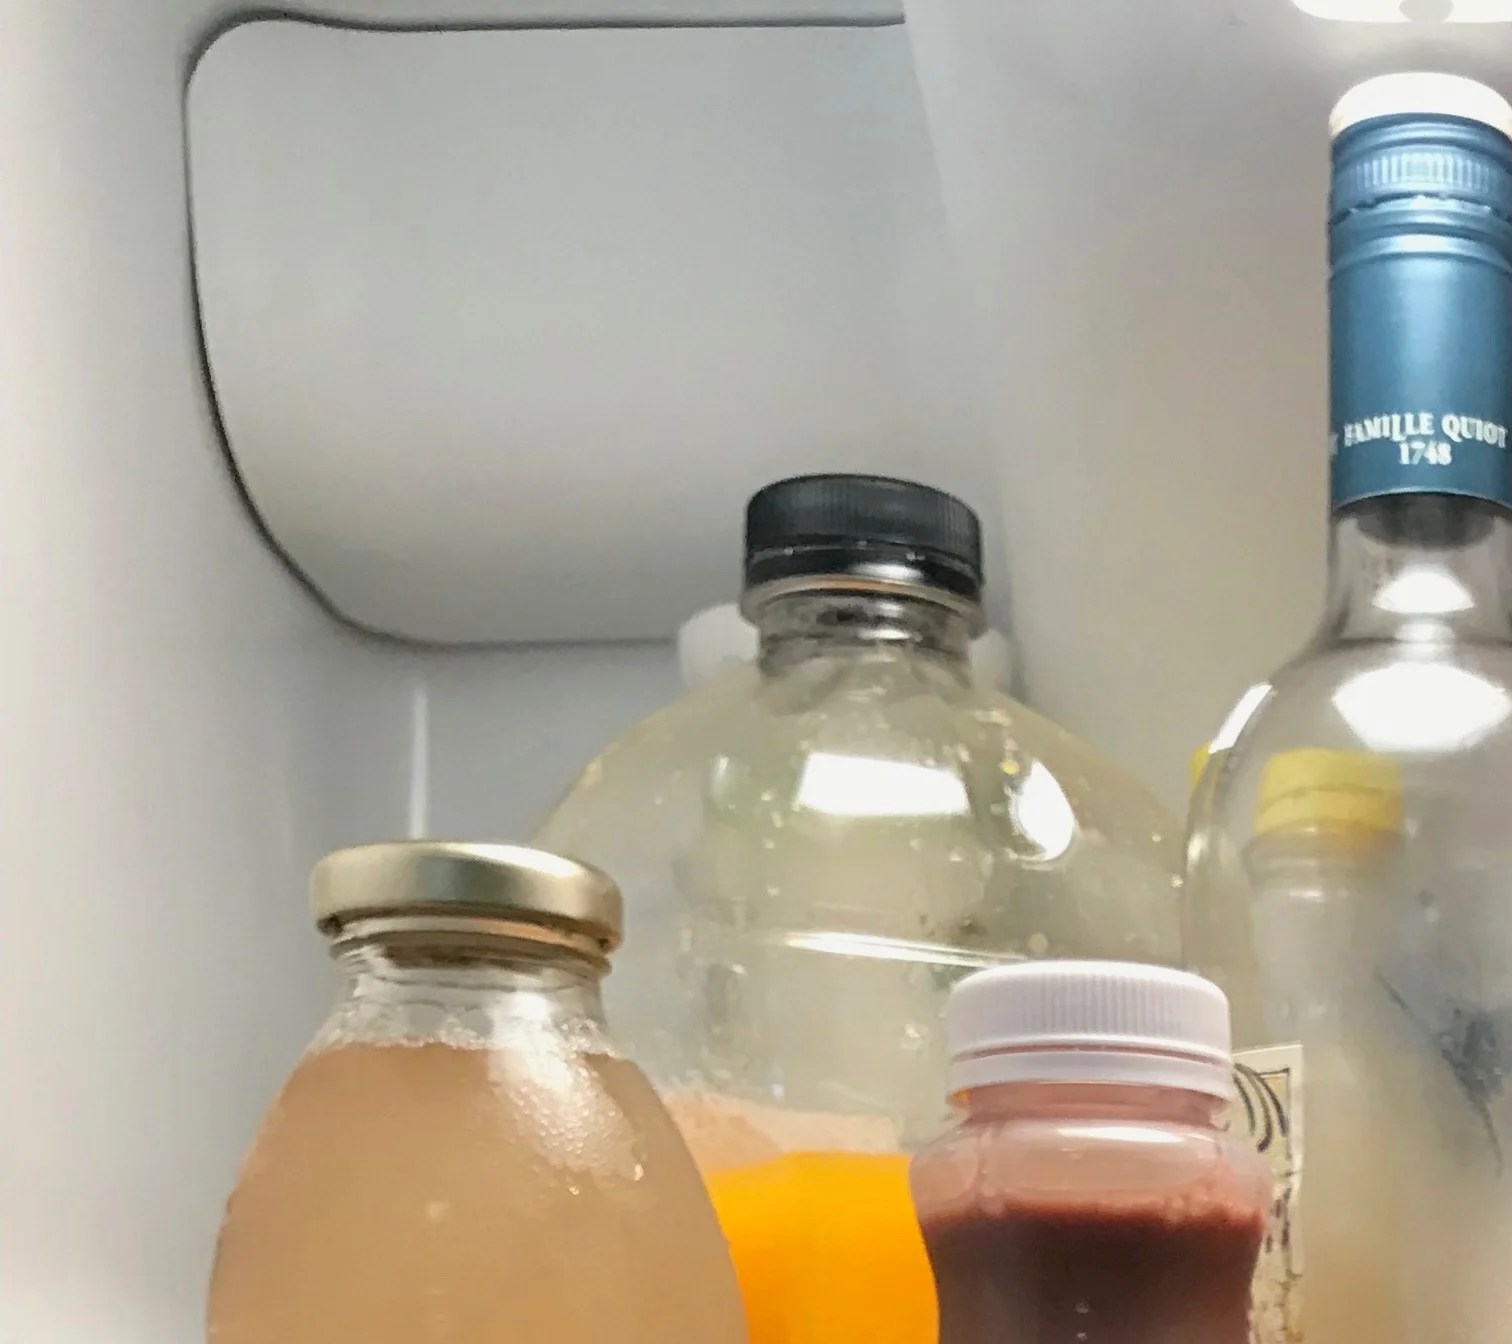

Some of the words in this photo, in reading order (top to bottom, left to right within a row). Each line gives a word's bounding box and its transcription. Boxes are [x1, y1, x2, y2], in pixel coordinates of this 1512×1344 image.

[1343, 412, 1436, 447] FAMILLE
[1441, 413, 1509, 449] QUIOT
[1399, 441, 1453, 465] 1748
